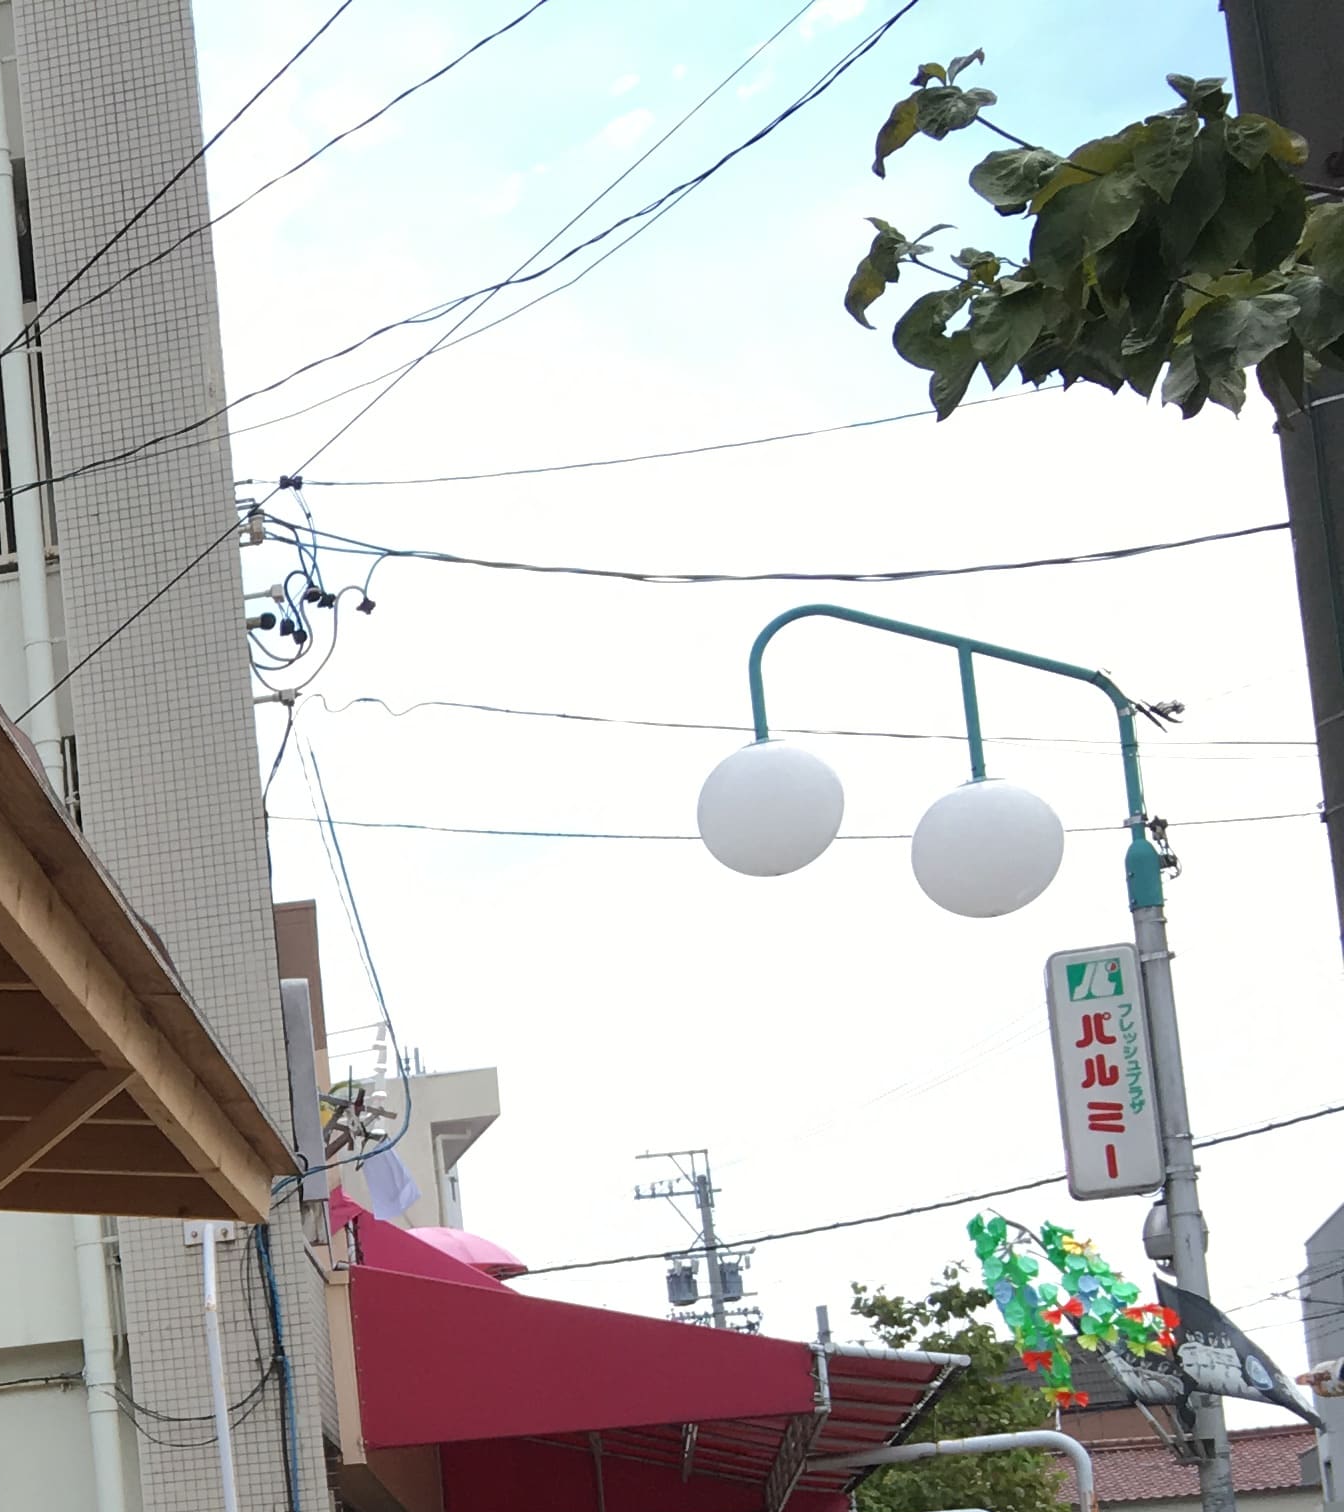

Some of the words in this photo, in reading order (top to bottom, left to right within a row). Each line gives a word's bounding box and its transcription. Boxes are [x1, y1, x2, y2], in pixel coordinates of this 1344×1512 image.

[1075, 1012, 1126, 1179] パルミー
[1117, 1003, 1146, 1115] フレッシュプラザ
